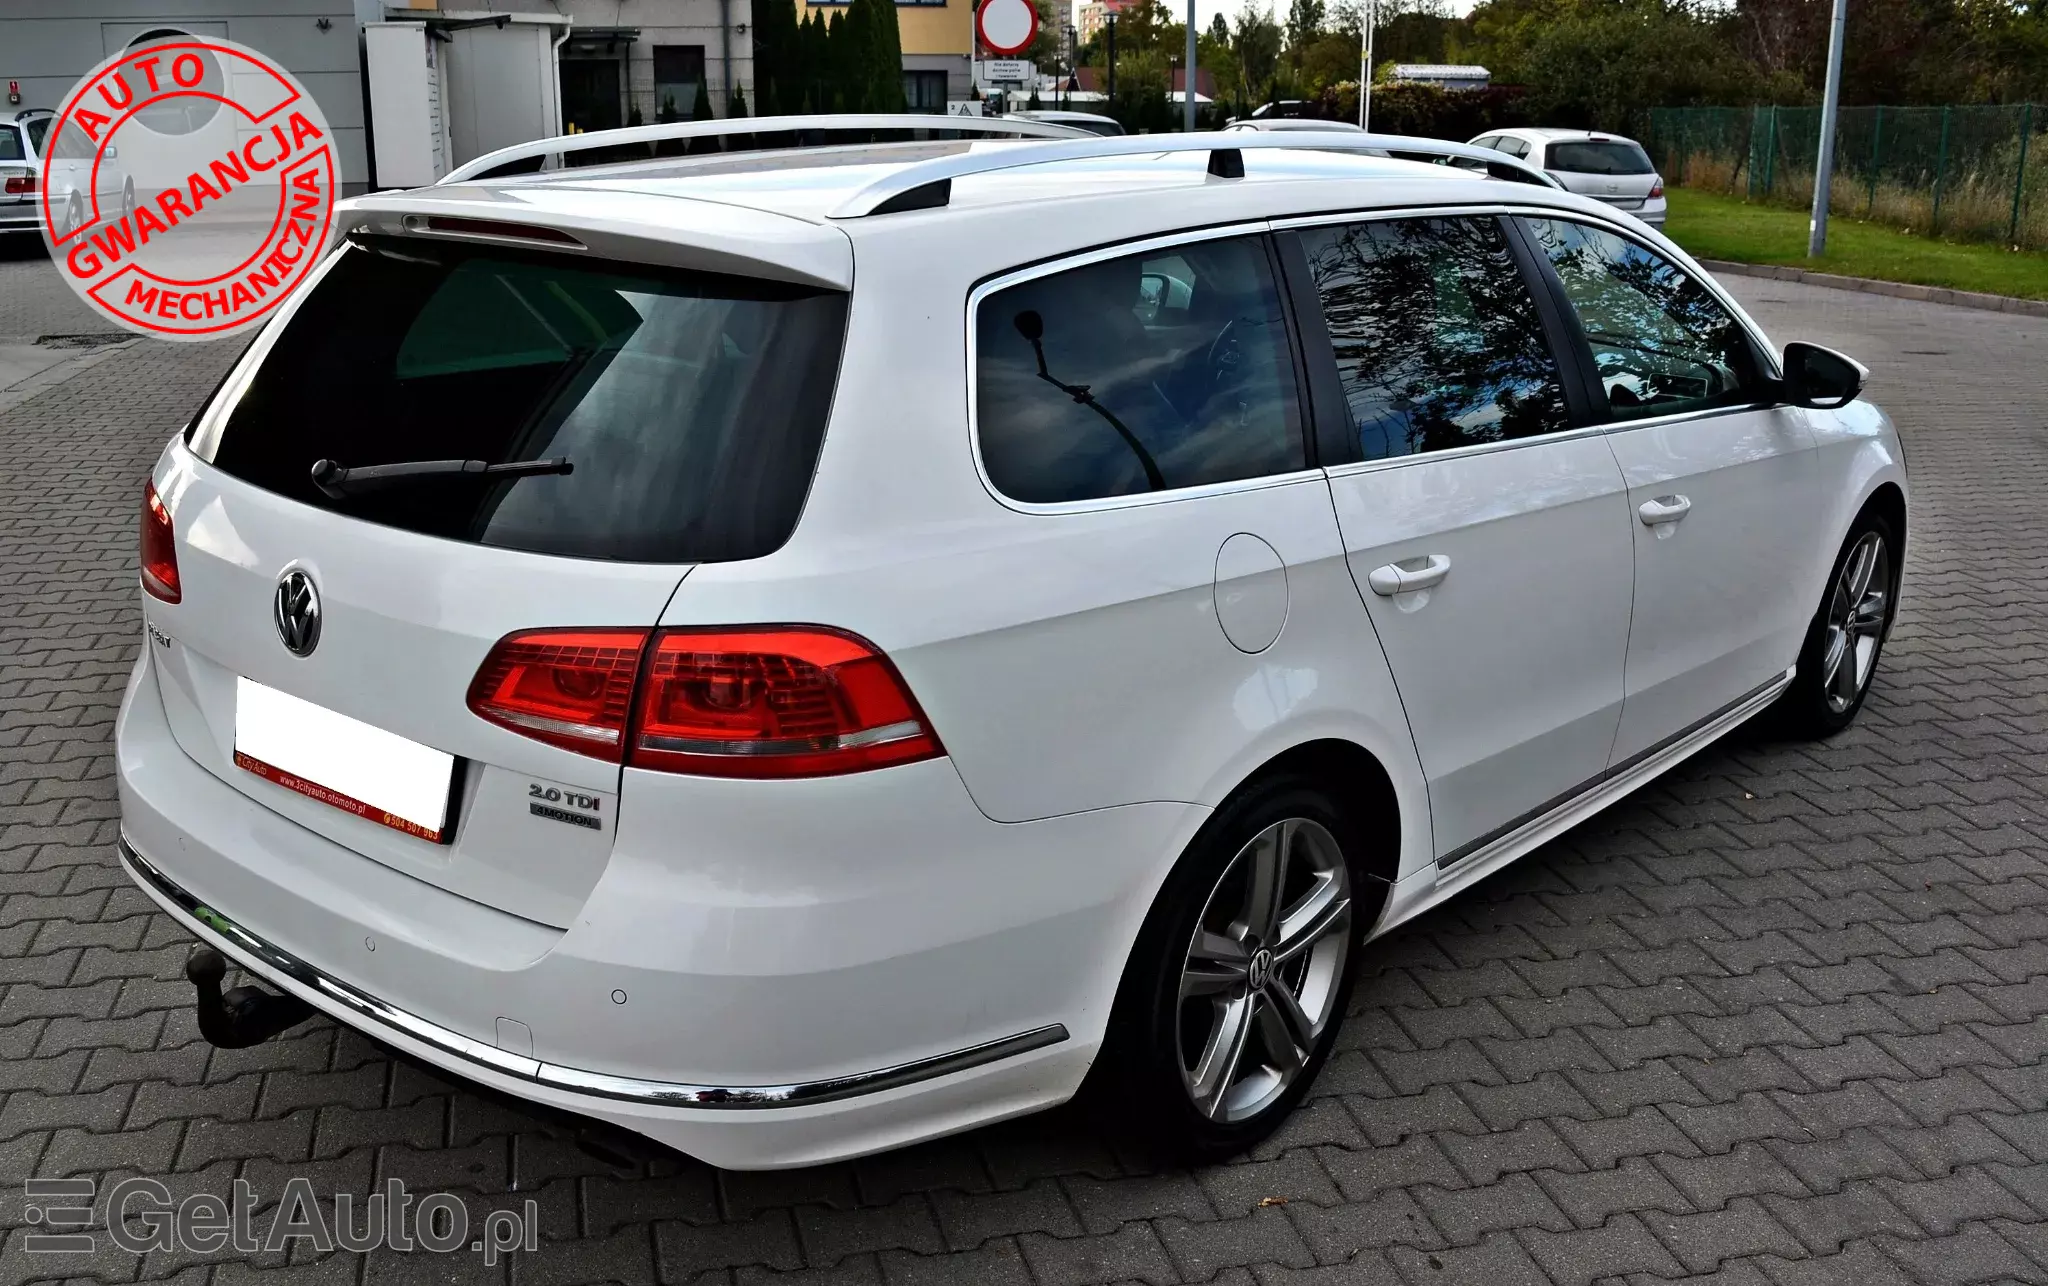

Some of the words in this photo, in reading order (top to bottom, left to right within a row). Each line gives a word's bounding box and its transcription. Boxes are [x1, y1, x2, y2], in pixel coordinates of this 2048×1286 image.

[280, 775, 366, 815] www.3cityauto.otomoto.pl
[528, 783, 562, 802] 2.0
[564, 791, 600, 811] TDI
[391, 816, 405, 829] 504
[407, 822, 421, 834] 507
[423, 829, 438, 840] 963
[536, 806, 593, 827] 4MOTION
